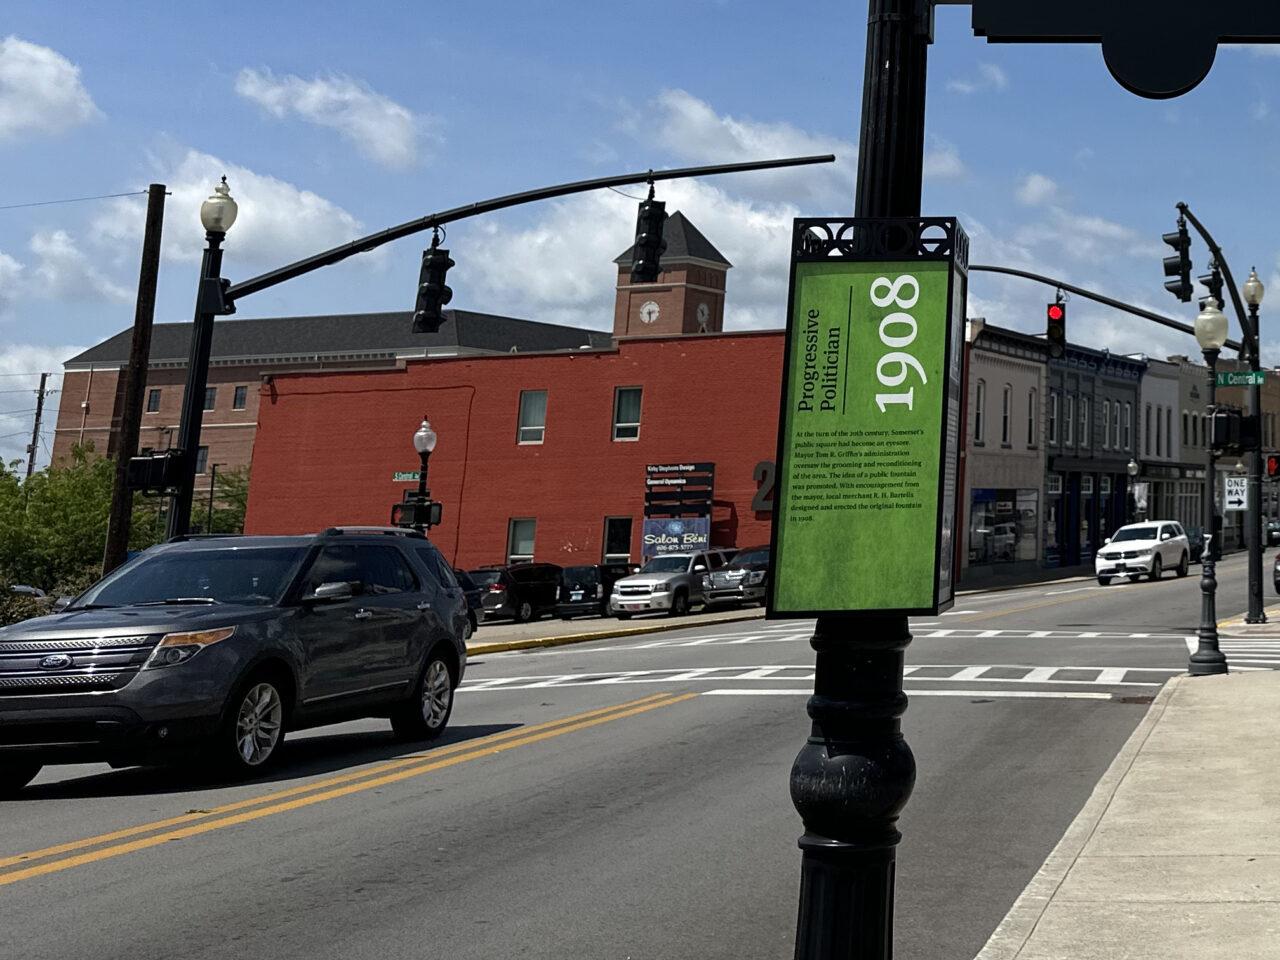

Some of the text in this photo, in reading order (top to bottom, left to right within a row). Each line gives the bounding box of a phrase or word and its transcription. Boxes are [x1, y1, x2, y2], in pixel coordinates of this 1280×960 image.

[869, 274, 928, 413] 1908
[798, 308, 820, 413] Progressive
[820, 326, 841, 413] Politician
[1217, 373, 1225, 385] N
[1227, 372, 1256, 385] Central
[1226, 479, 1246, 488] ONE
[1226, 487, 1247, 496] WAY
[644, 532, 708, 545] Salon Béni
